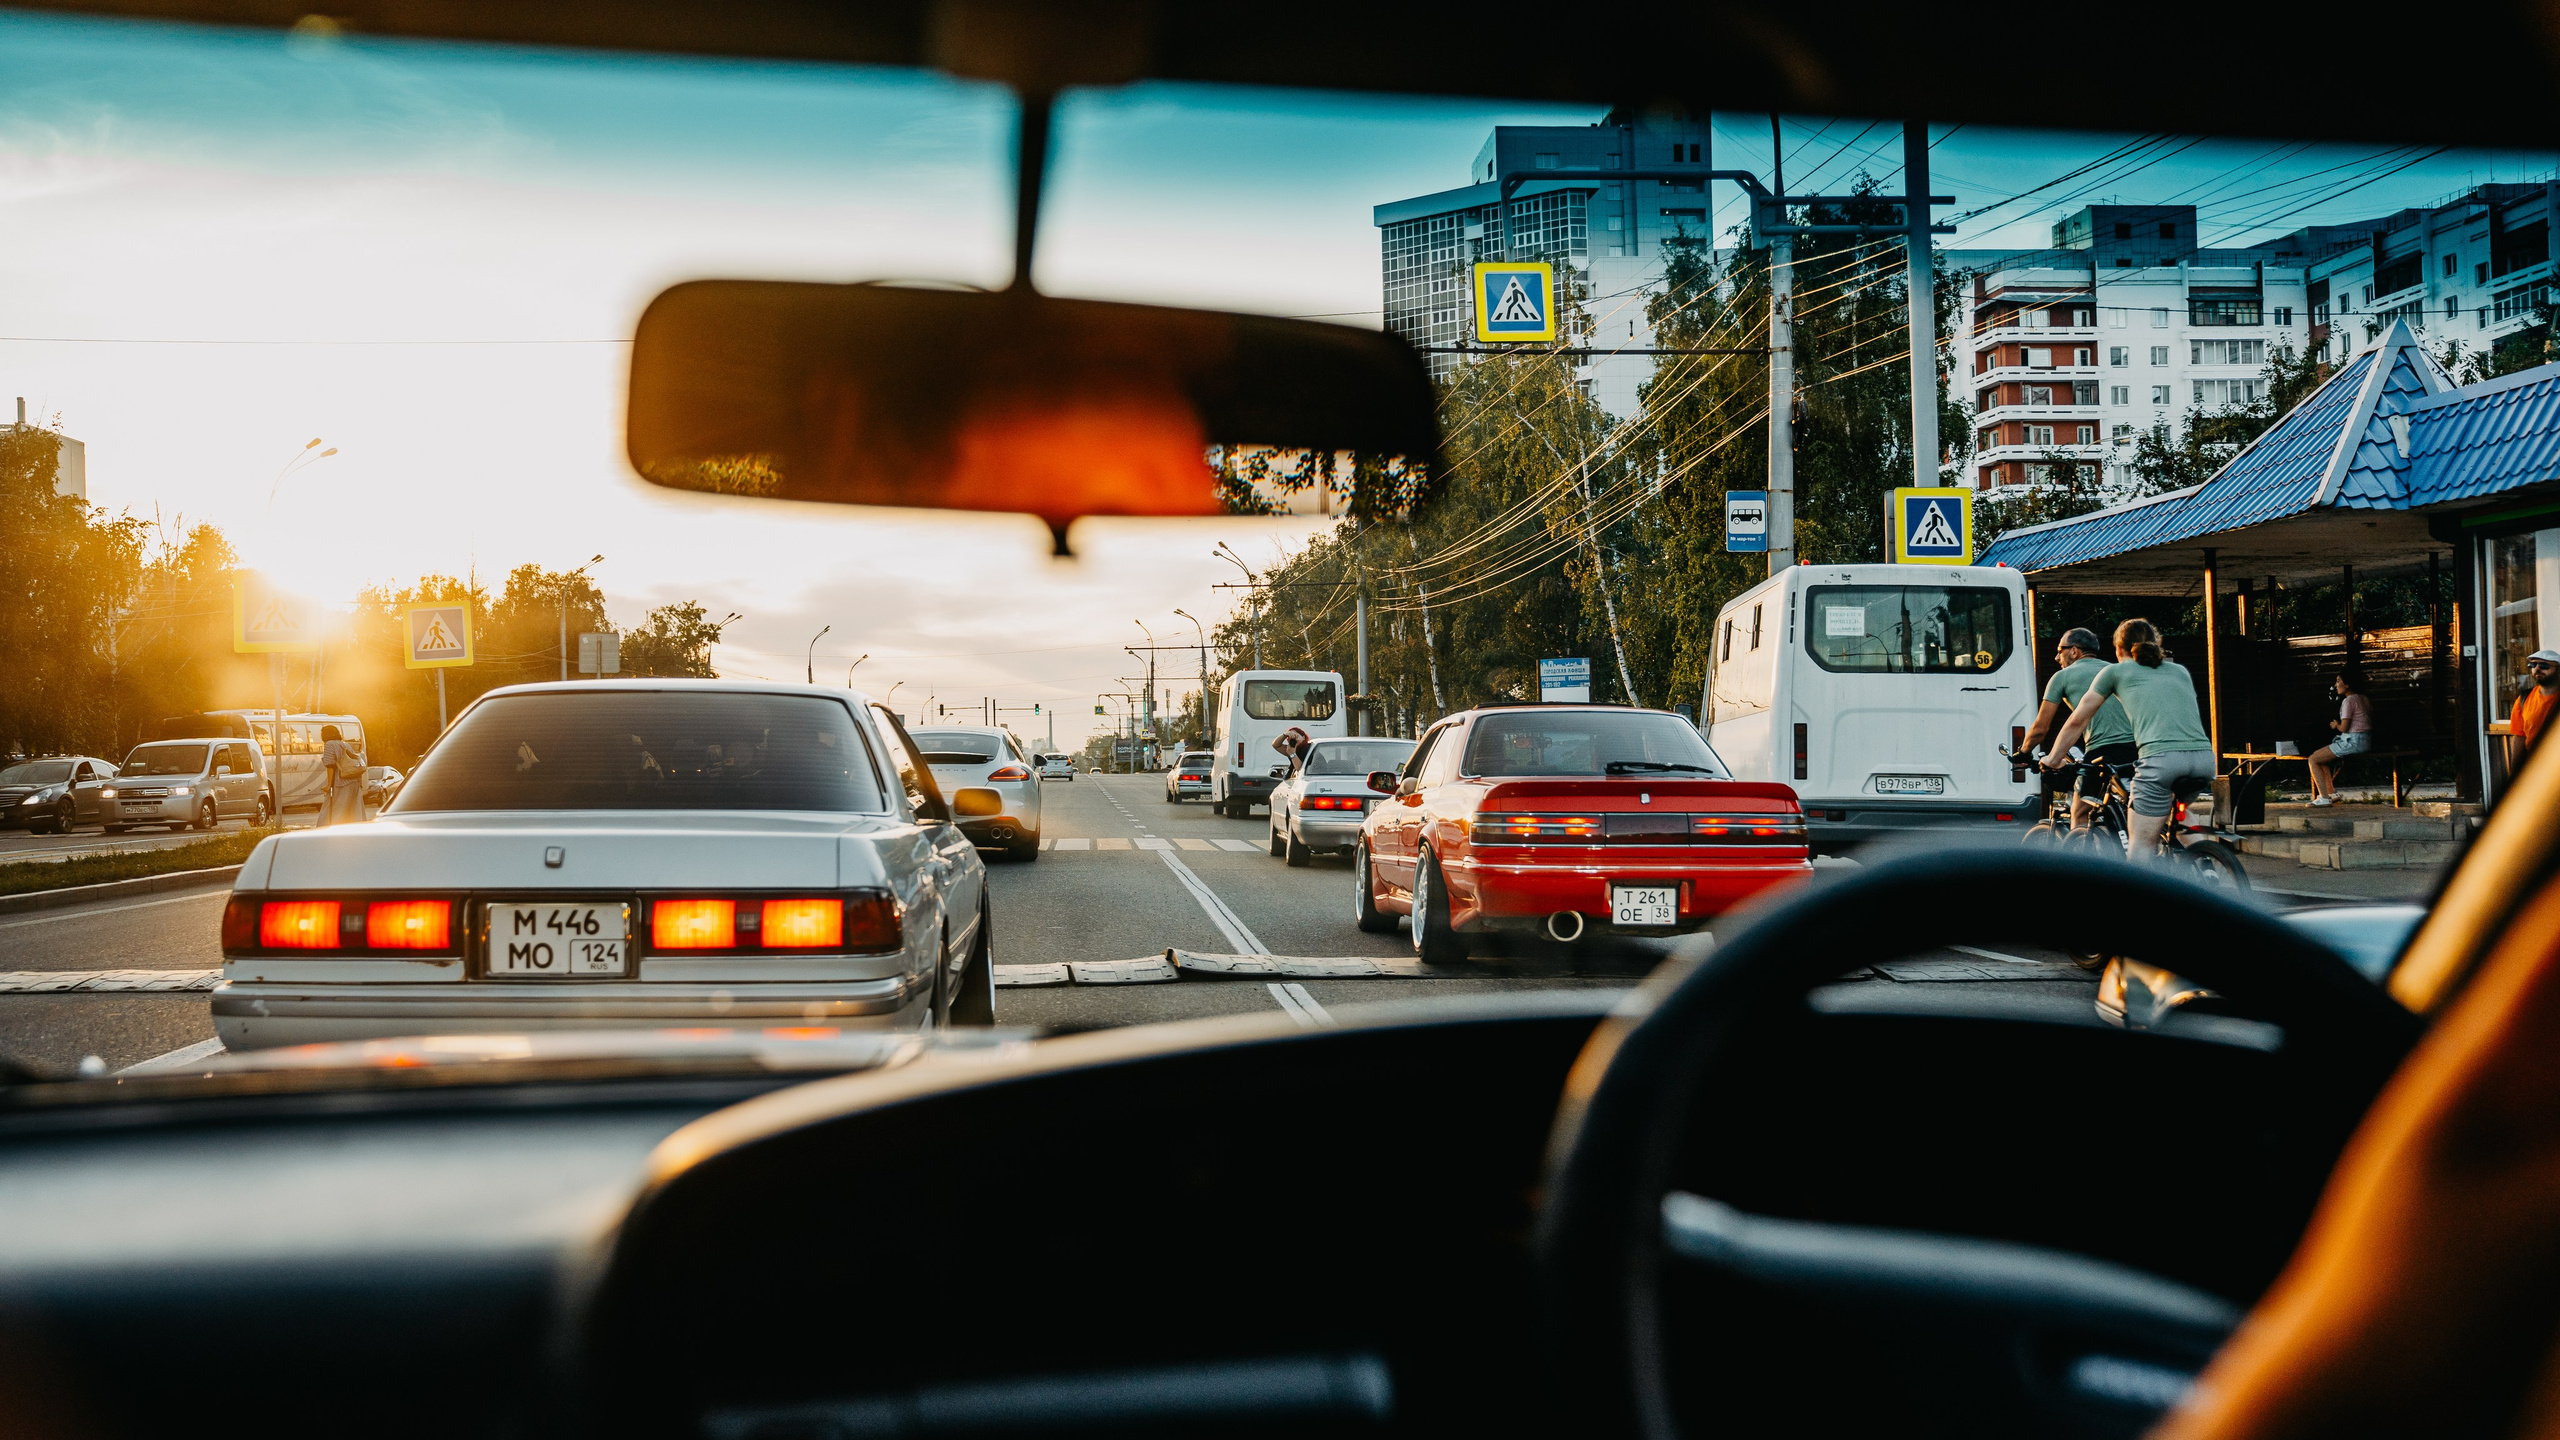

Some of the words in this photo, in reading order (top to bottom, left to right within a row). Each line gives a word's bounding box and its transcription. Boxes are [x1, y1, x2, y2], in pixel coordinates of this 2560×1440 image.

[1977, 654, 1990, 665] 56
[1639, 891, 1666, 904] 261
[1620, 908, 1643, 921] ОЕ
[1656, 907, 1669, 918] 38
[547, 910, 600, 935] 446
[509, 942, 553, 969] МО
[582, 943, 618, 962] 124
